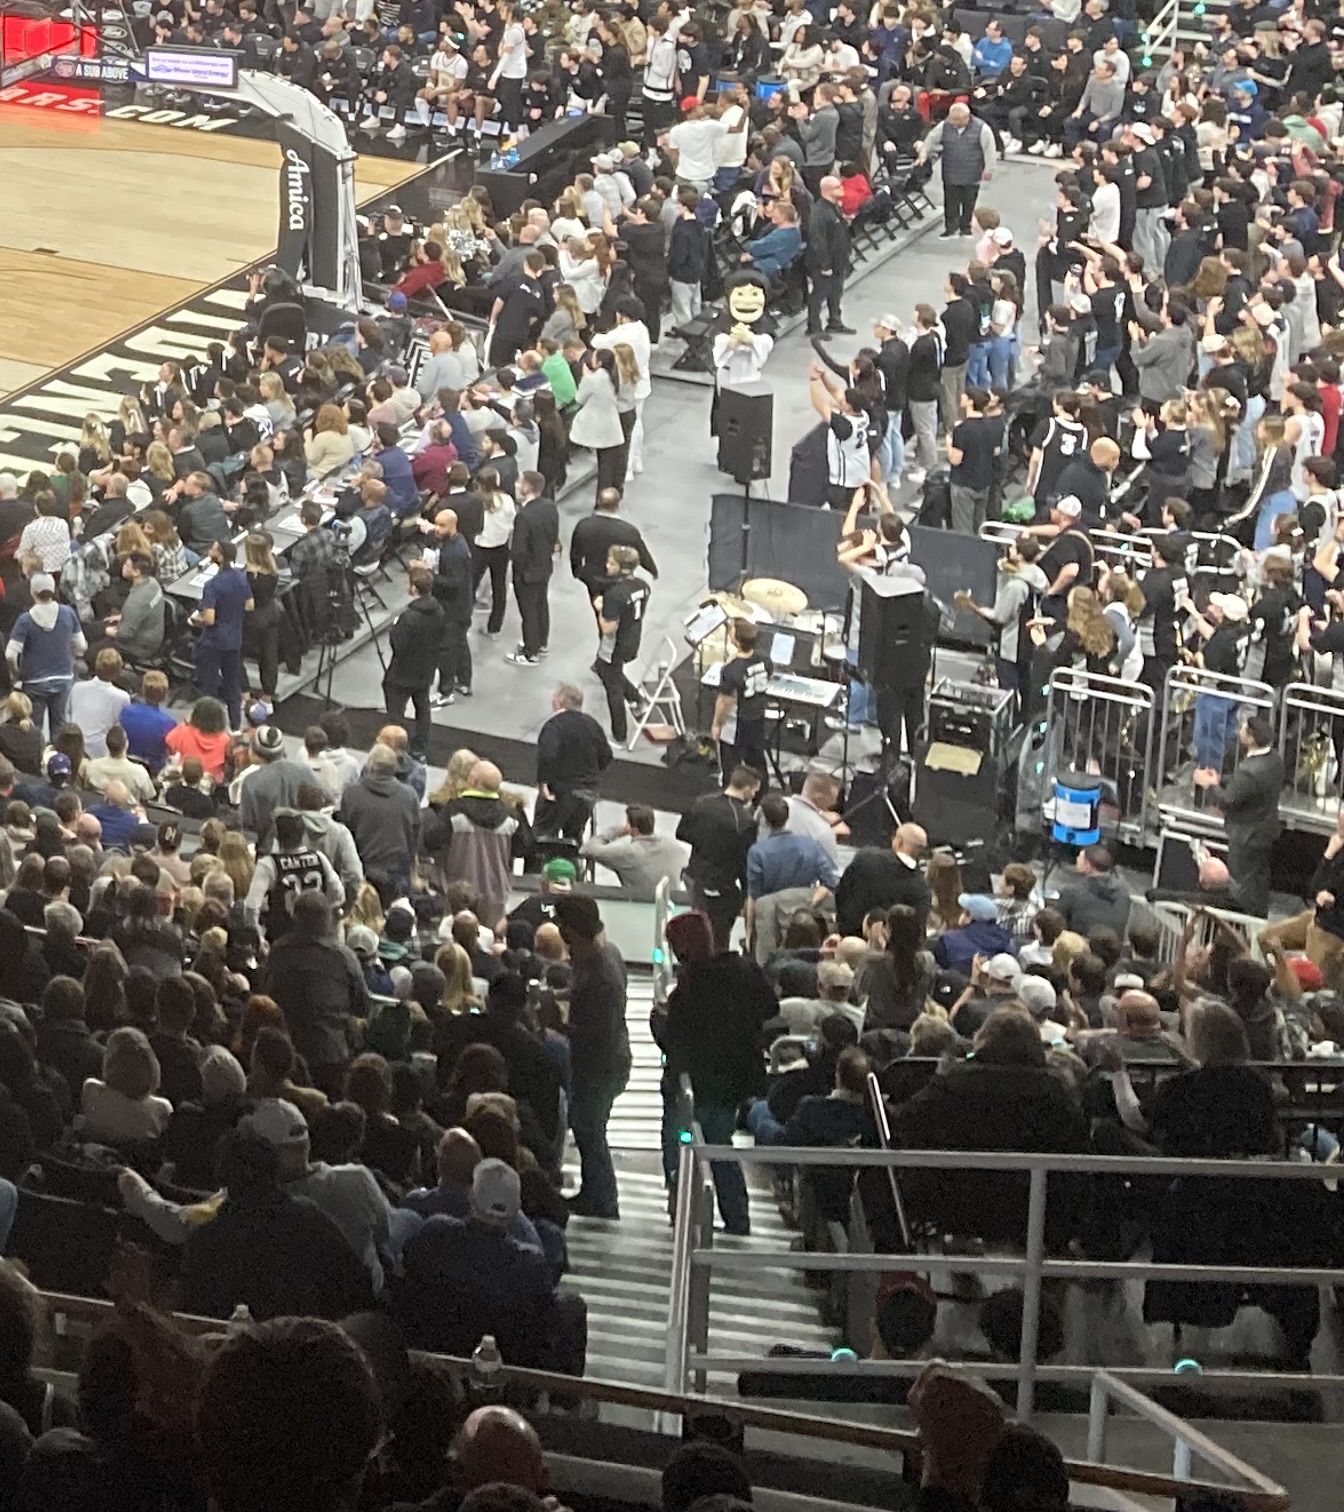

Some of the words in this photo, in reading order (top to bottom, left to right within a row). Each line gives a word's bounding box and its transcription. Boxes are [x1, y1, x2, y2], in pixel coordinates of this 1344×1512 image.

[76, 65, 82, 76] A
[84, 66, 100, 78] SUB
[102, 66, 129, 80] ABOVE
[286, 148, 310, 230] Amica
[1060, 433, 1077, 455] 3
